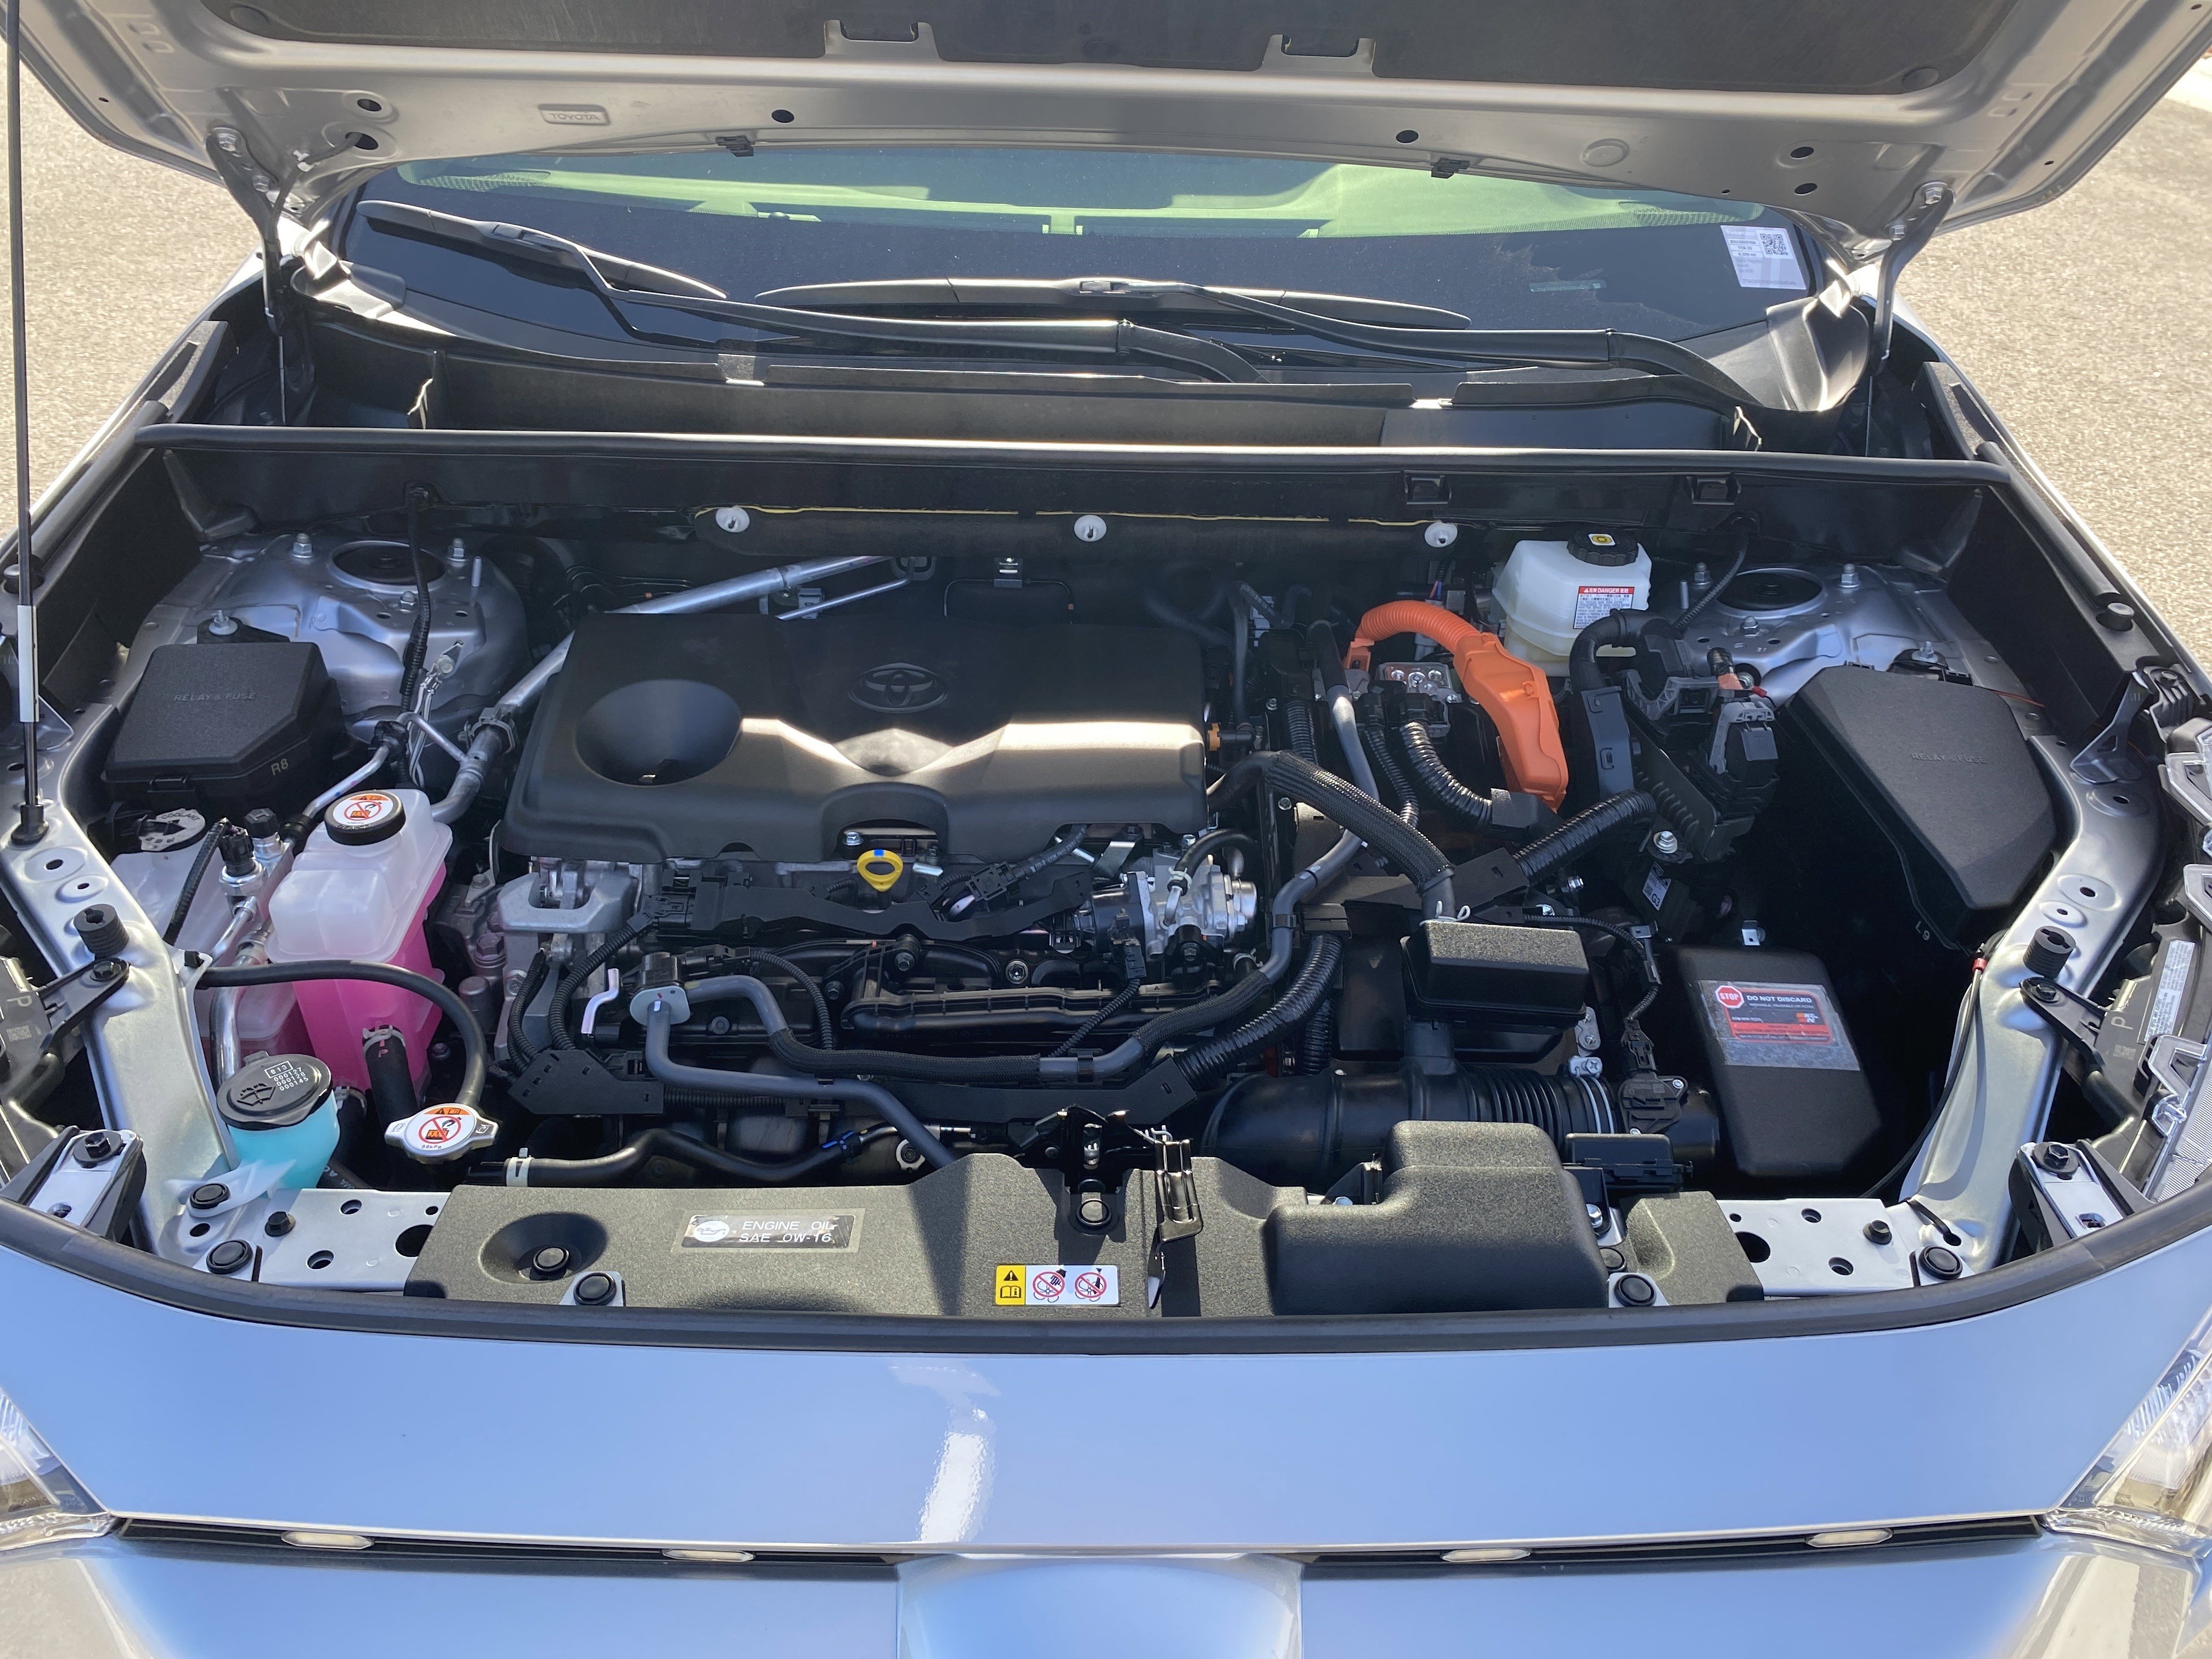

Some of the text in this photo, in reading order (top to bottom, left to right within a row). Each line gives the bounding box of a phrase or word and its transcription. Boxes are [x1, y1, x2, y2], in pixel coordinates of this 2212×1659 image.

[173, 693, 212, 702] RELAY
[225, 692, 256, 700] FUSE
[1911, 753, 1945, 761] RELAY
[1957, 755, 1987, 764] FUSE
[270, 758, 289, 776] R8
[161, 812, 200, 821] COOLANT
[1651, 893, 1660, 907] G3
[7, 995, 33, 1007] P
[1719, 992, 1739, 1001] STOP
[2111, 1016, 2134, 1030] P
[273, 1066, 302, 1082] 000127
[276, 1071, 306, 1086] 000128
[279, 1076, 309, 1091] 000145
[742, 1221, 835, 1231] ENGINE OIL
[738, 1233, 832, 1243] SAE 0W-16
